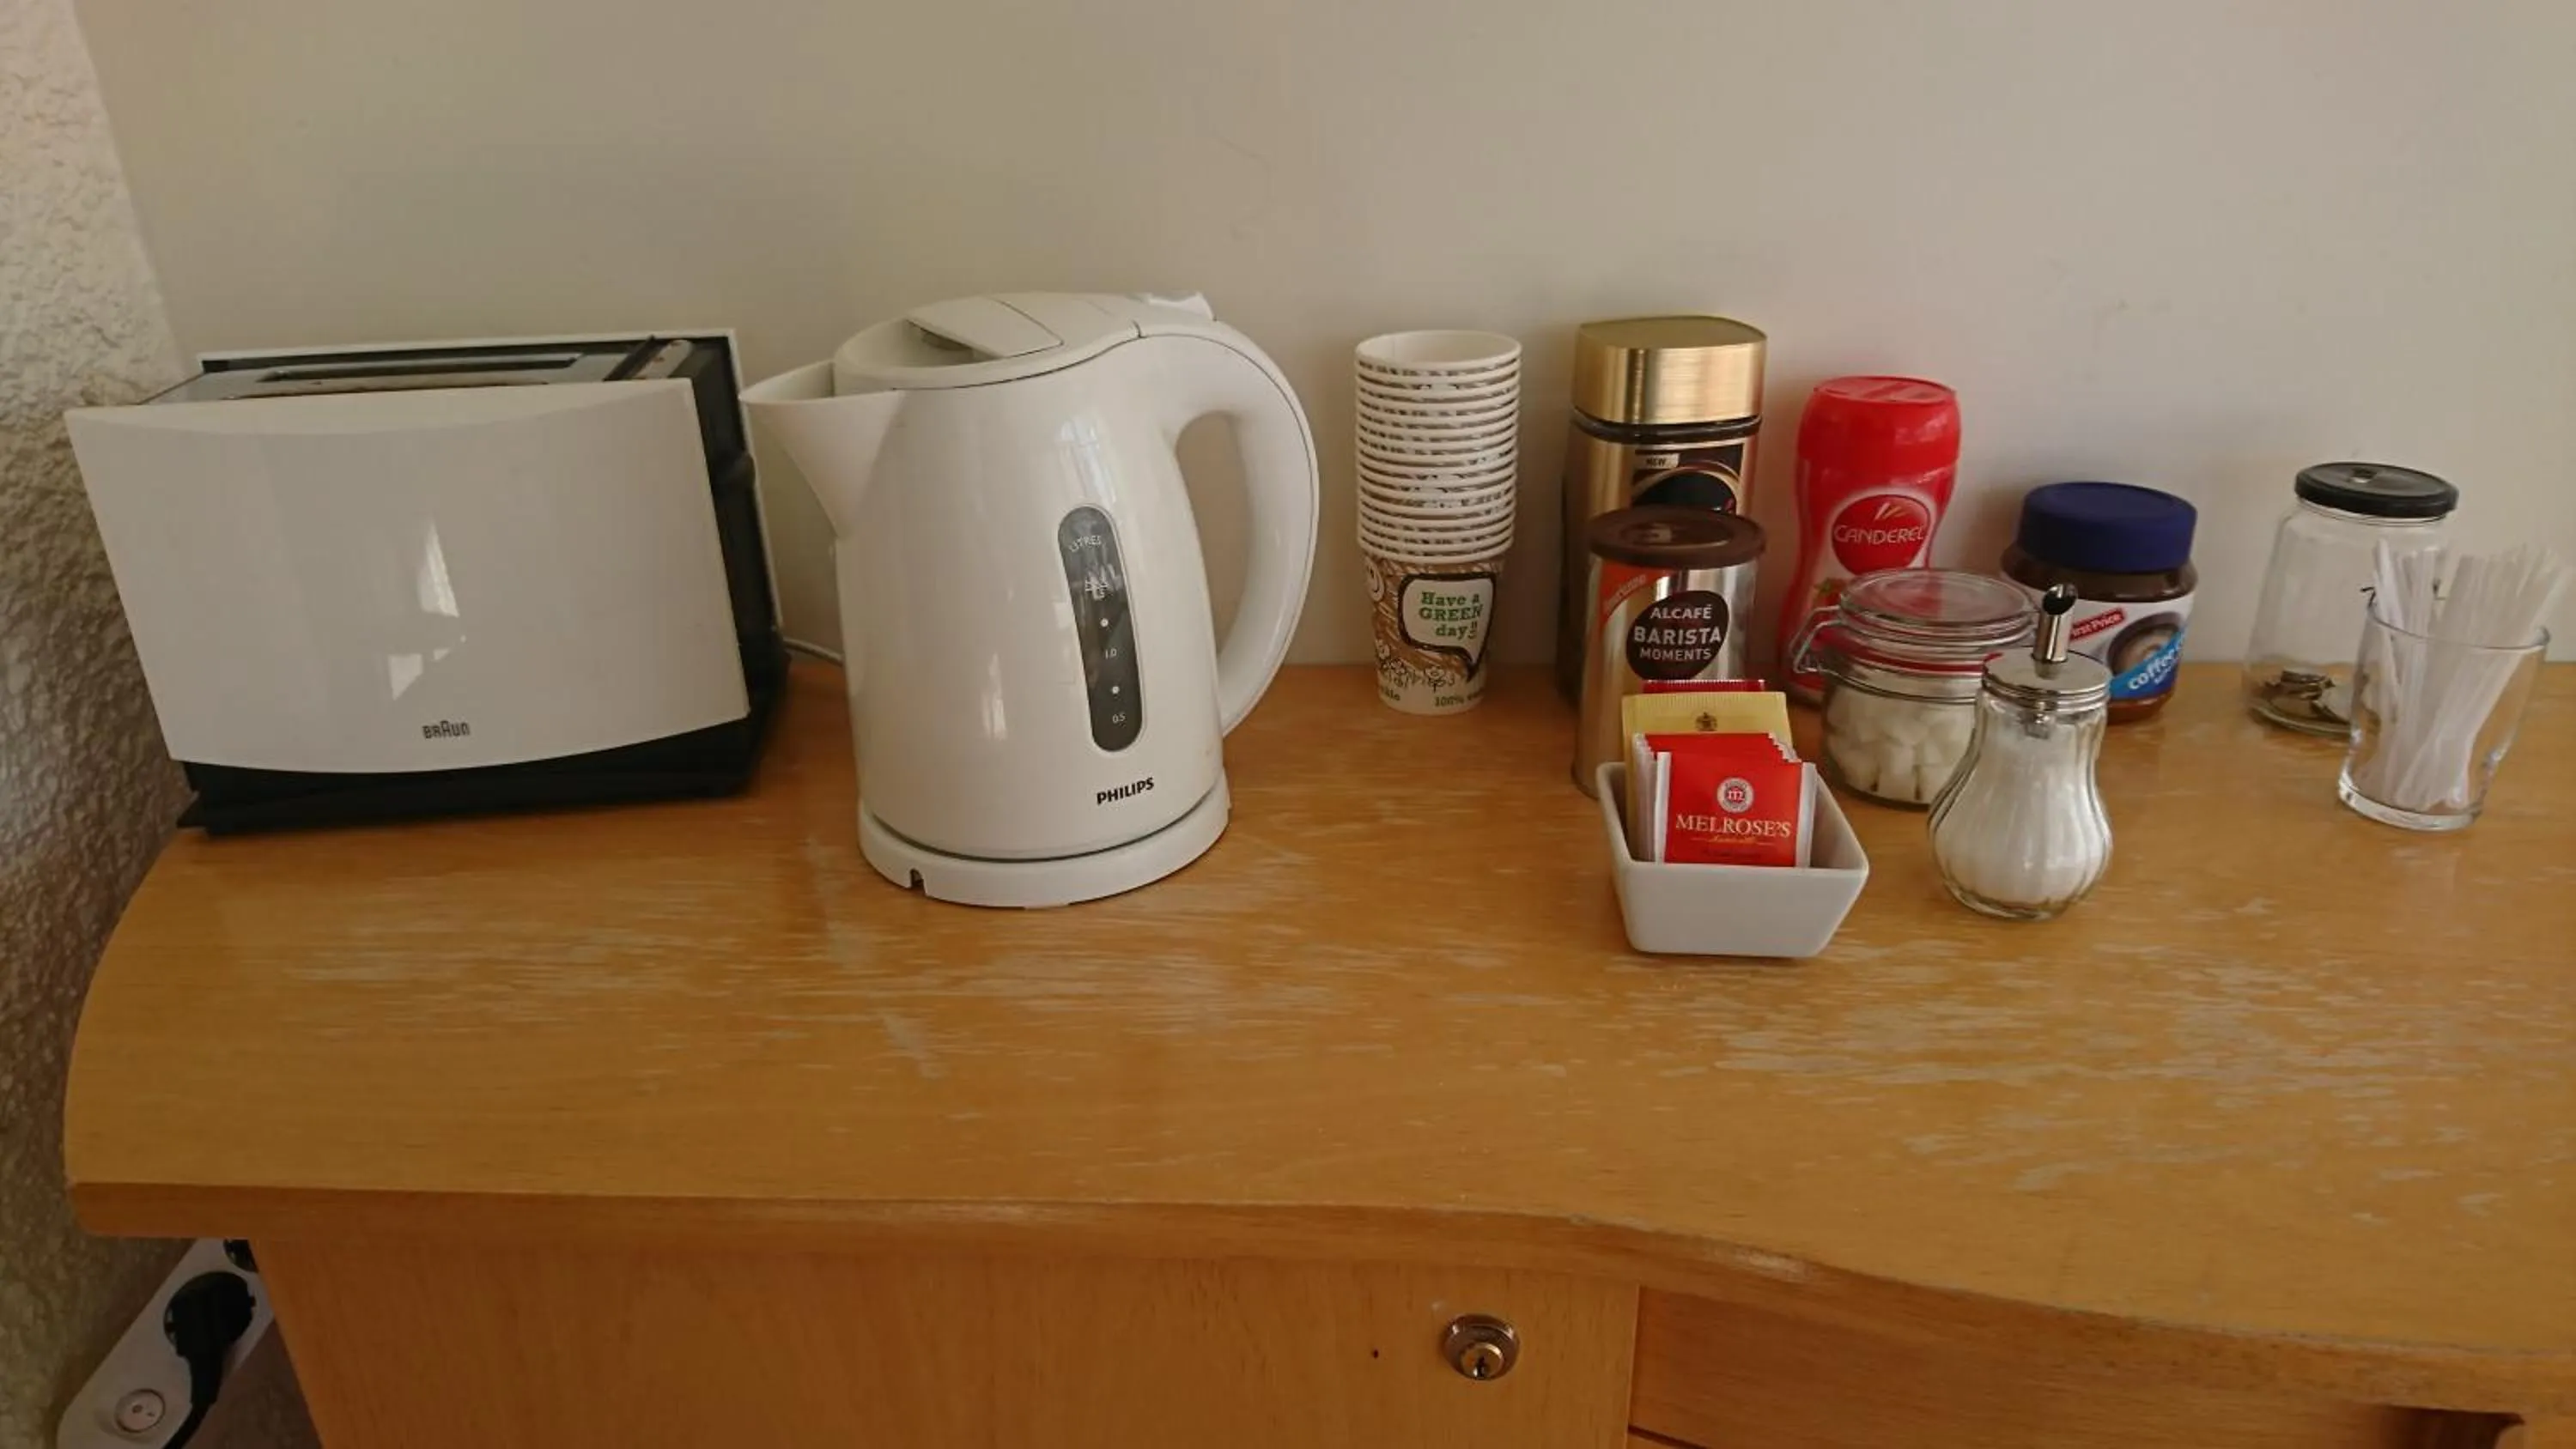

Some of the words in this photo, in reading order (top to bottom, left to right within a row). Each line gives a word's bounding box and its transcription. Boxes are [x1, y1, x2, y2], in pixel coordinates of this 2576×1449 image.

[1833, 524, 1925, 545] CANDEREL
[1421, 591, 1467, 605] Have
[1472, 593, 1480, 603] a
[1419, 604, 1483, 621] GREEN
[1649, 603, 1713, 620] ALCAFÉ
[1633, 626, 1722, 645] BARISTA
[1639, 647, 1713, 662] MOMENTS
[422, 719, 471, 739] BRAUN
[1096, 777, 1155, 805] PHILIPS
[1675, 813, 1792, 839] MELROSE'S
